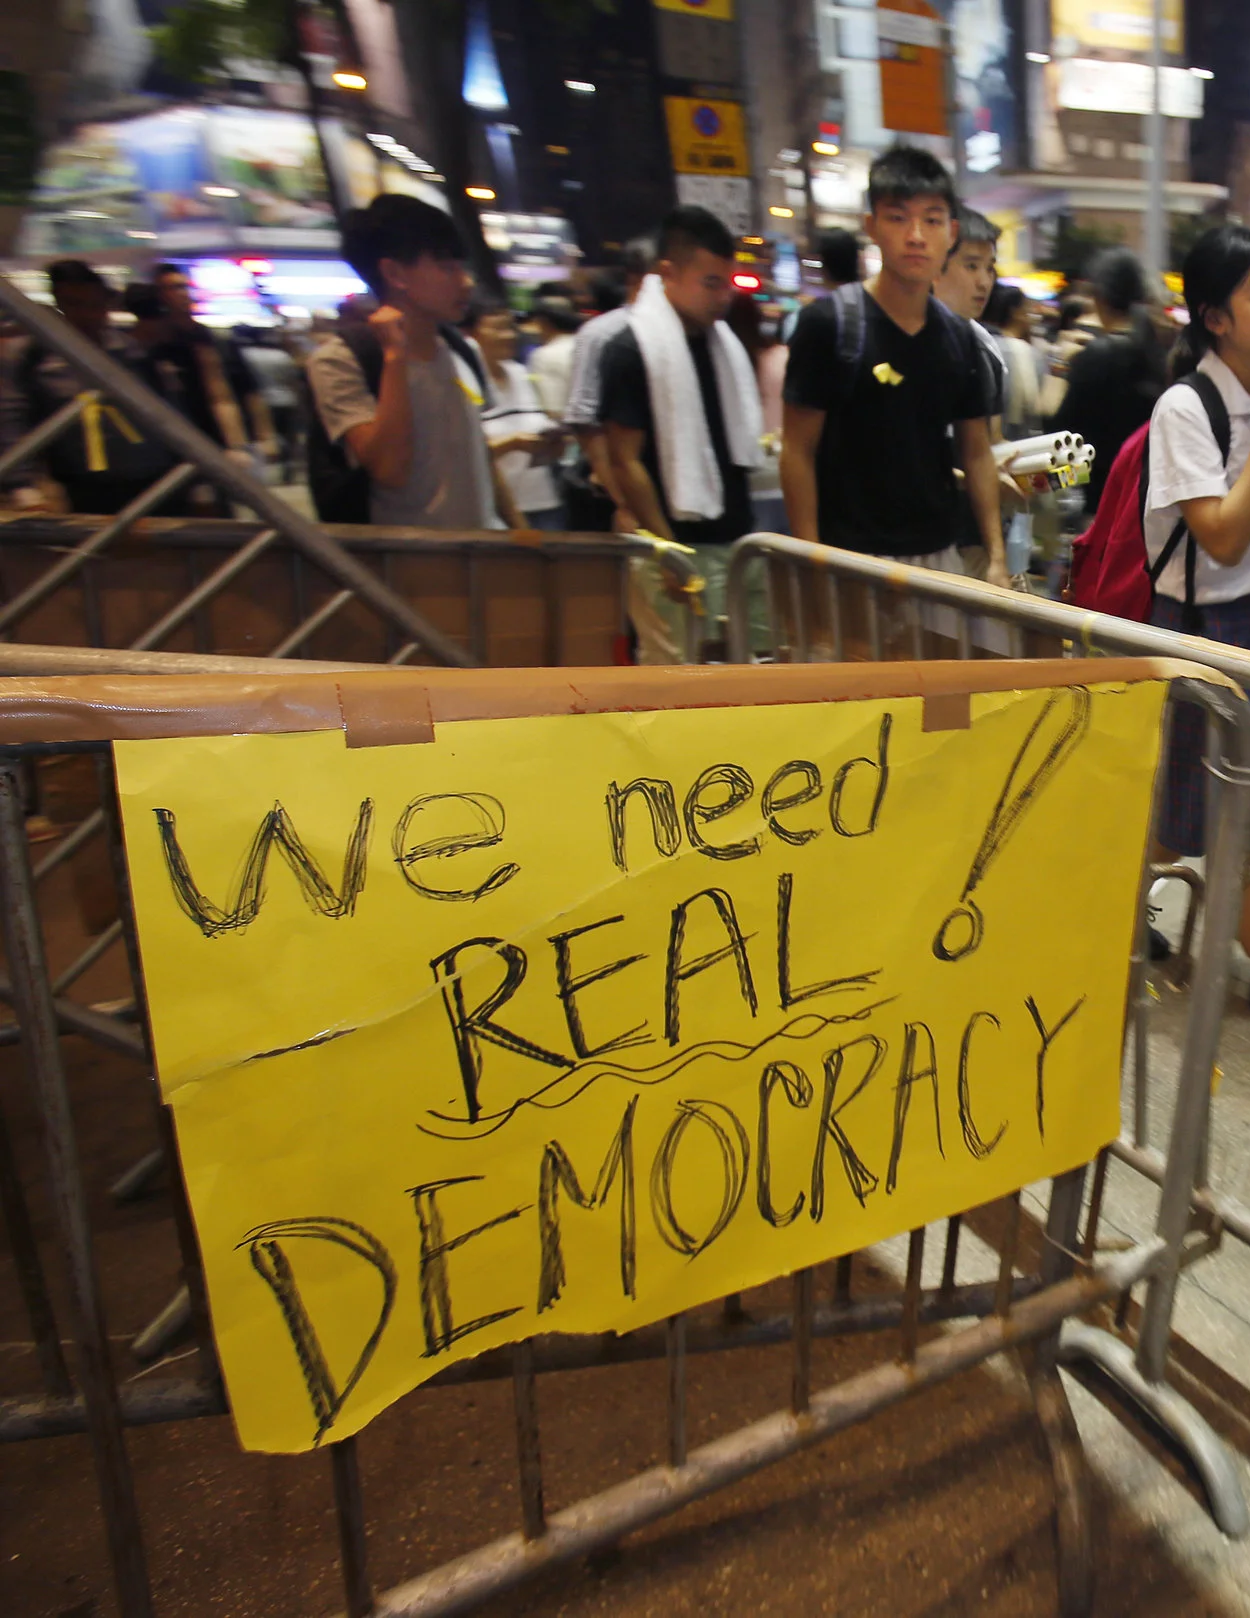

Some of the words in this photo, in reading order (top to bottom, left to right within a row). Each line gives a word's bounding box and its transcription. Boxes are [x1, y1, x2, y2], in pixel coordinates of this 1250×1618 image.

[151, 791, 522, 939] We
[605, 712, 893, 873] need
[429, 872, 884, 1125] REAL
[233, 993, 1089, 1449] DEMOCRACY
